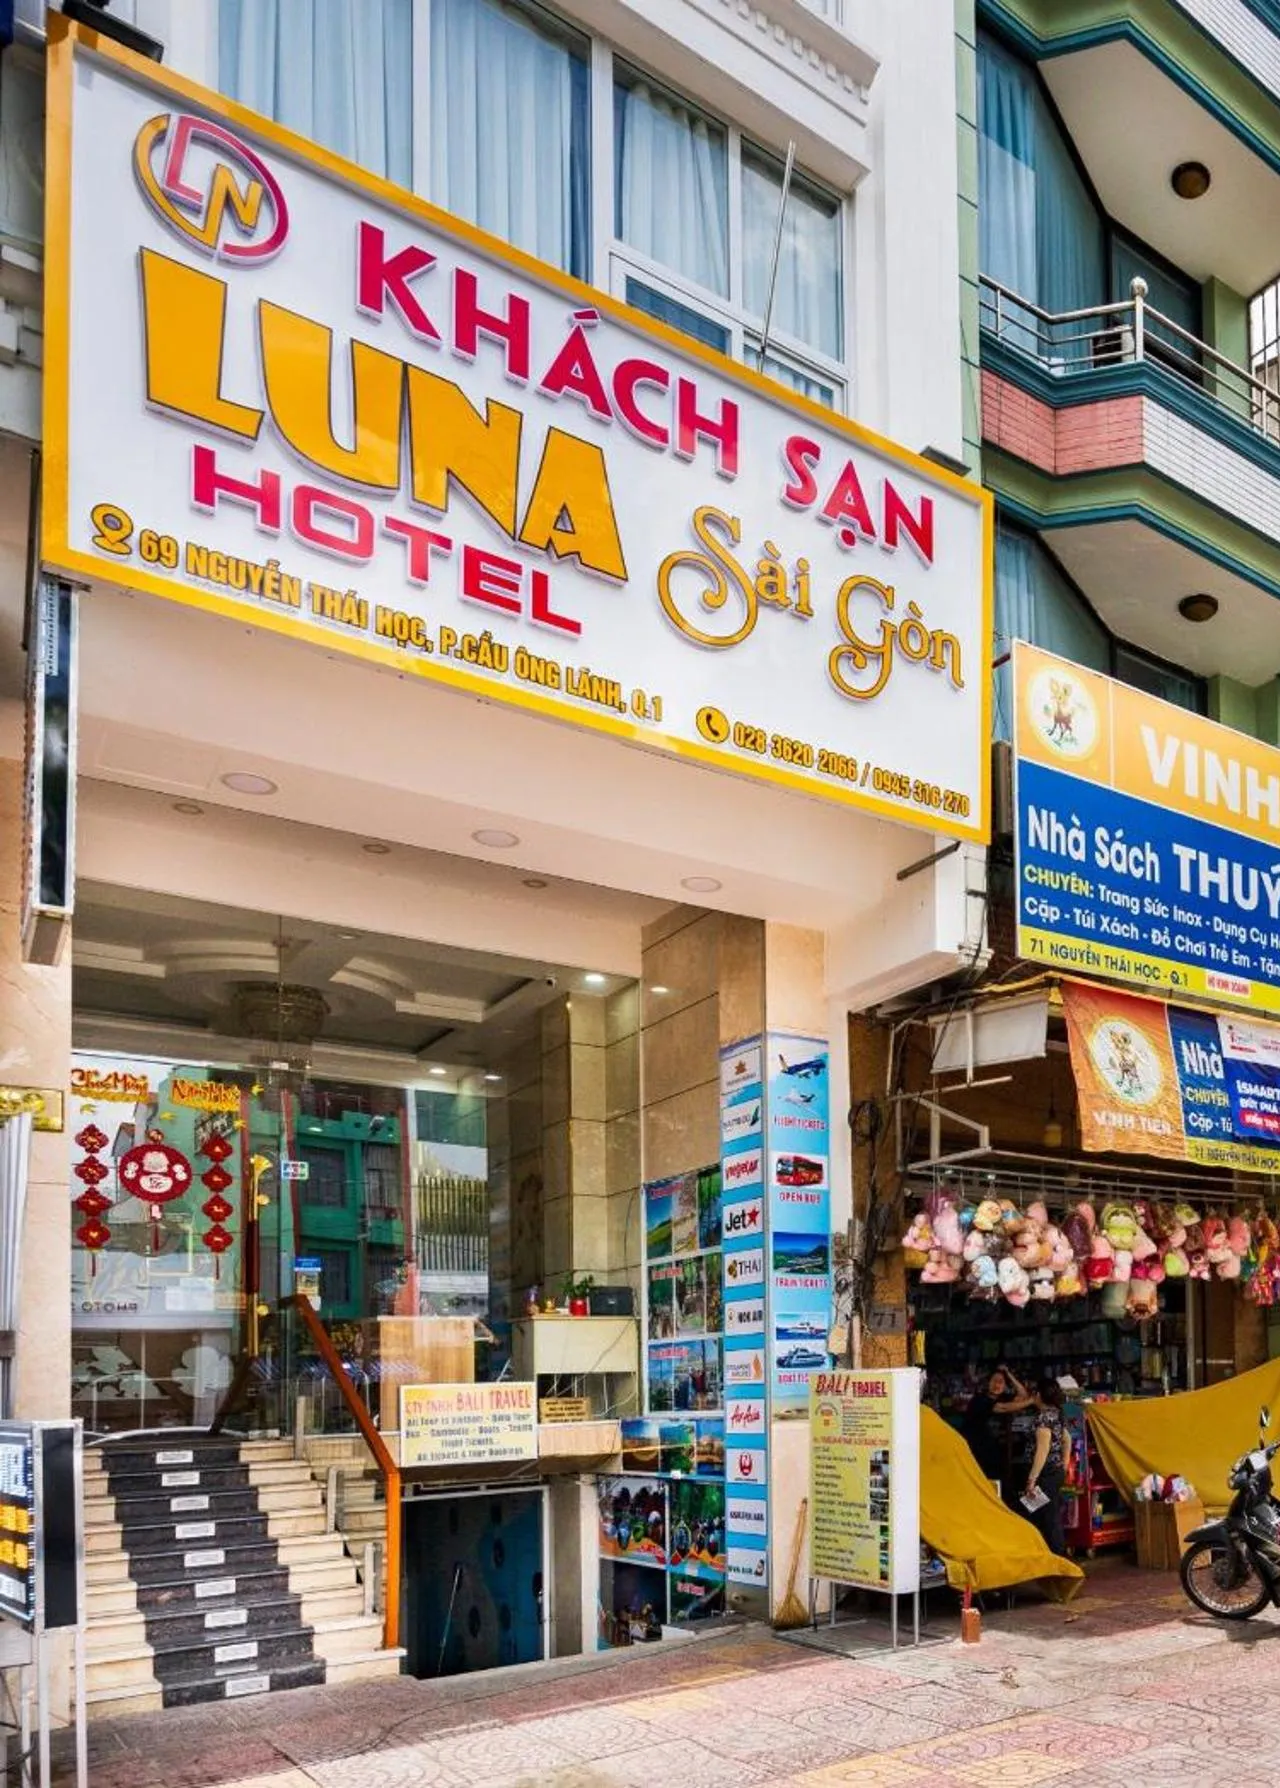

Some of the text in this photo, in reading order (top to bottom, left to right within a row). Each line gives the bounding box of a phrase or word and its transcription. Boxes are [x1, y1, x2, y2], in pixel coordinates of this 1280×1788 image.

[138, 246, 629, 583] LUNA
[357, 220, 936, 568] KHÁCH SẠN
[192, 444, 582, 637] HOTEL
[139, 528, 179, 569] 69
[185, 541, 301, 608] NGUYỄN
[309, 583, 370, 630] THÁI
[375, 603, 435, 655] HỌC,
[514, 655, 561, 691] ÔNG
[631, 688, 663, 722] Q.1
[657, 505, 965, 701] Sài Gòn
[733, 723, 767, 755] 028
[771, 734, 813, 767] 3620
[818, 747, 858, 782] 2066
[872, 767, 911, 798] 0945
[943, 787, 970, 817] 270
[1140, 724, 1280, 830] VINH
[1027, 804, 1086, 863] Nhà
[1094, 826, 1161, 884] Sách
[1024, 864, 1095, 899] CHUYÊN:
[1098, 883, 1140, 916] Trang
[1143, 897, 1169, 919] Sức
[1173, 904, 1202, 928] Inox
[1213, 915, 1247, 943] Dụng
[1250, 927, 1268, 946] Cụ
[1024, 896, 1060, 924] Cặp
[1073, 907, 1096, 930] Túi
[1099, 914, 1139, 941] Xách
[1174, 934, 1207, 958] Chơi
[1209, 941, 1229, 963] Trẻ
[1232, 947, 1250, 968] Em
[1029, 938, 1045, 955] 71
[1104, 953, 1131, 974] THÁI
[1133, 961, 1161, 983] HỌC
[1169, 970, 1189, 987] Q.1
[1180, 1039, 1225, 1080] Nhà
[725, 1211, 750, 1232] Jet
[738, 1260, 762, 1276] THAI
[490, 1388, 532, 1410] TRAVEL
[815, 1374, 849, 1396] BALI
[851, 1381, 888, 1398] TRAVEL
